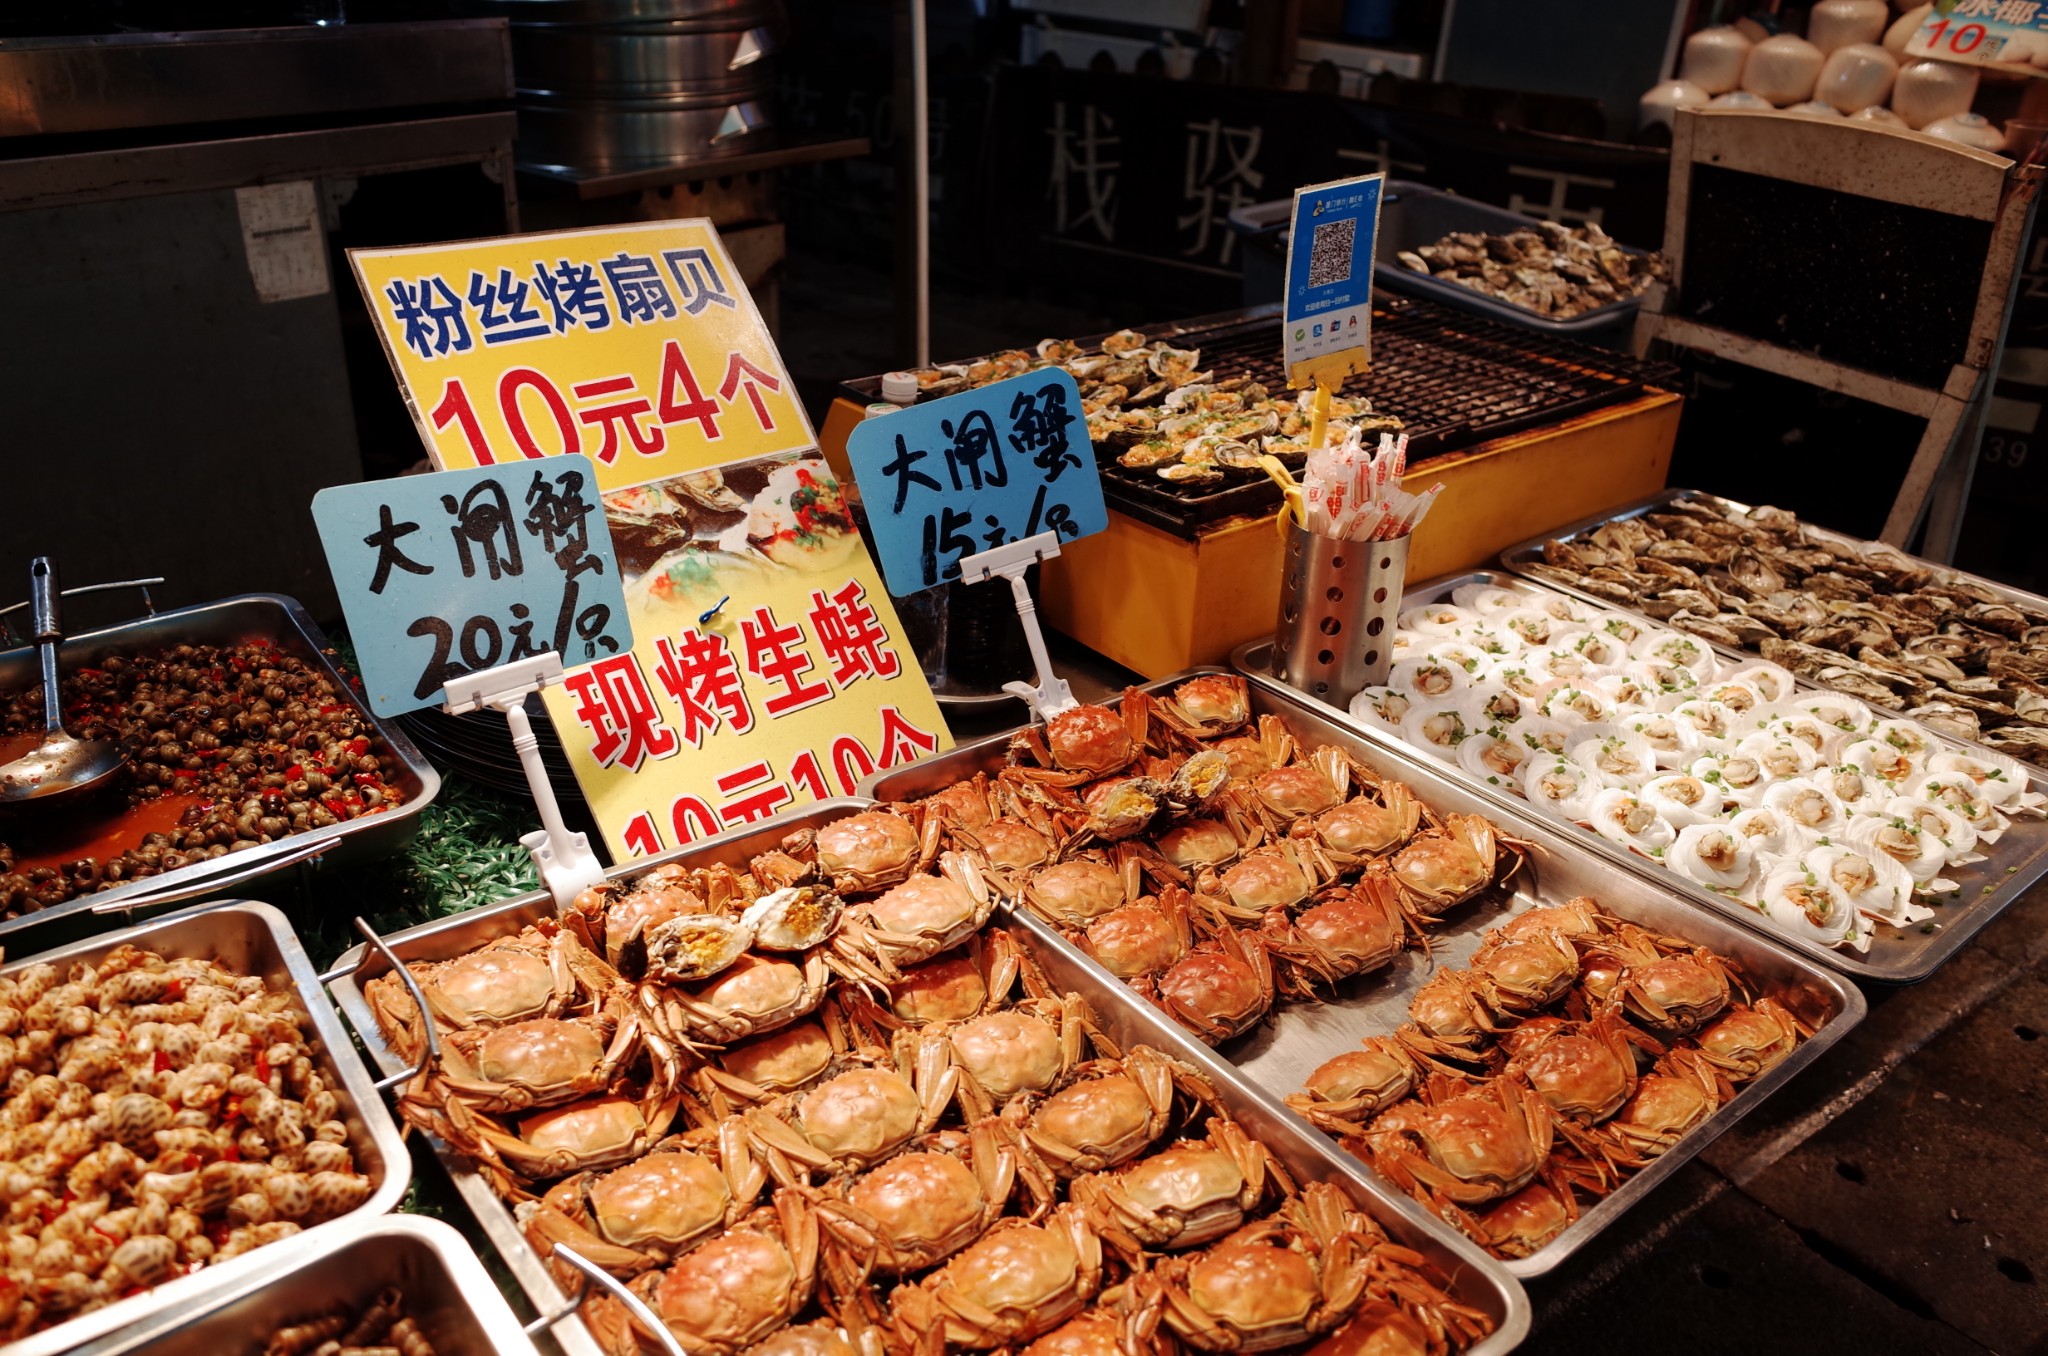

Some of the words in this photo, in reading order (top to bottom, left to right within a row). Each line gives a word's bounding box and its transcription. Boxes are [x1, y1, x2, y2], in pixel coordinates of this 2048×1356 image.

[1926, 18, 1987, 54] 10
[1951, 0, 2048, 32] 冰椰
[386, 247, 736, 358] 粉丝烤扇贝
[431, 340, 780, 466] 10元4个
[881, 383, 1083, 515] 大闸蟹
[363, 470, 604, 596] 大闸蟹
[564, 577, 900, 768] 现烤生蚝
